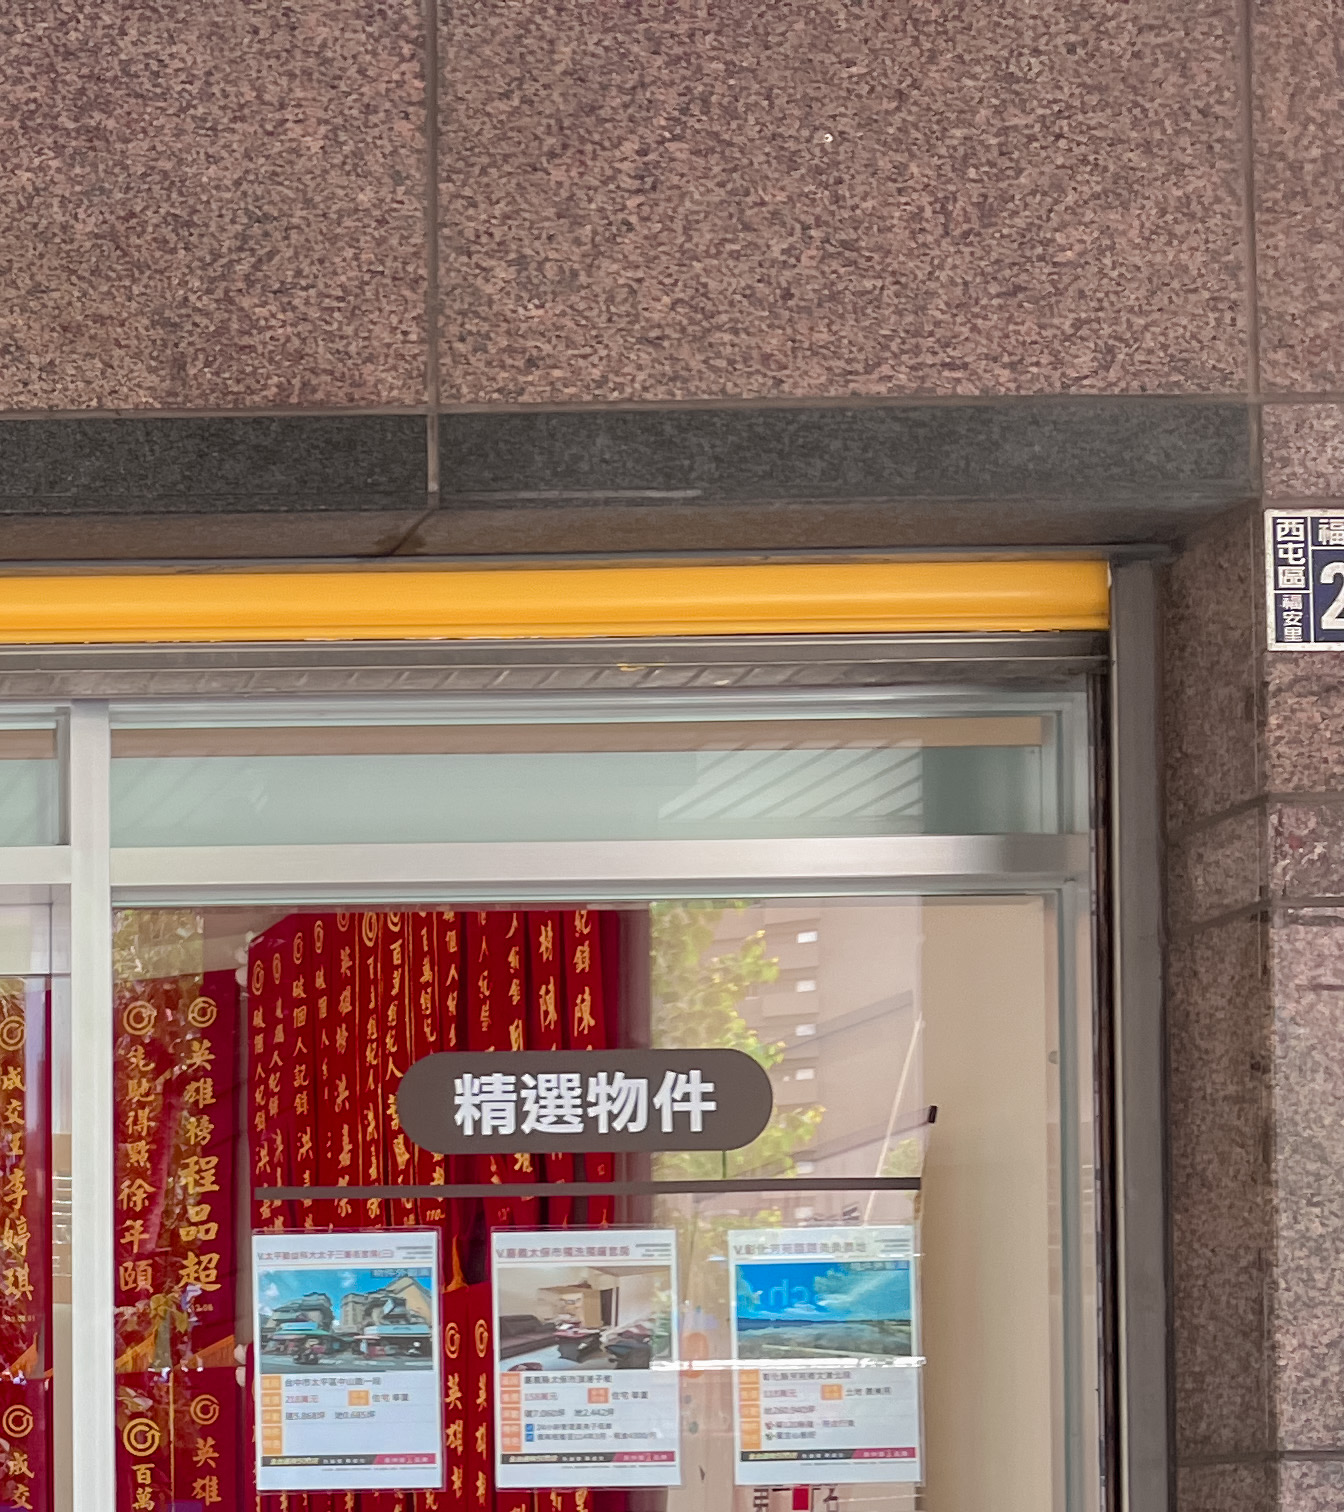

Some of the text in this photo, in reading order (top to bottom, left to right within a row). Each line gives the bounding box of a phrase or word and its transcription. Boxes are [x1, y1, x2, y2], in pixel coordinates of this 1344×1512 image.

[1276, 518, 1306, 589] 西屯區
[1281, 594, 1304, 642] 福安里
[453, 1069, 717, 1136] 精選物件
